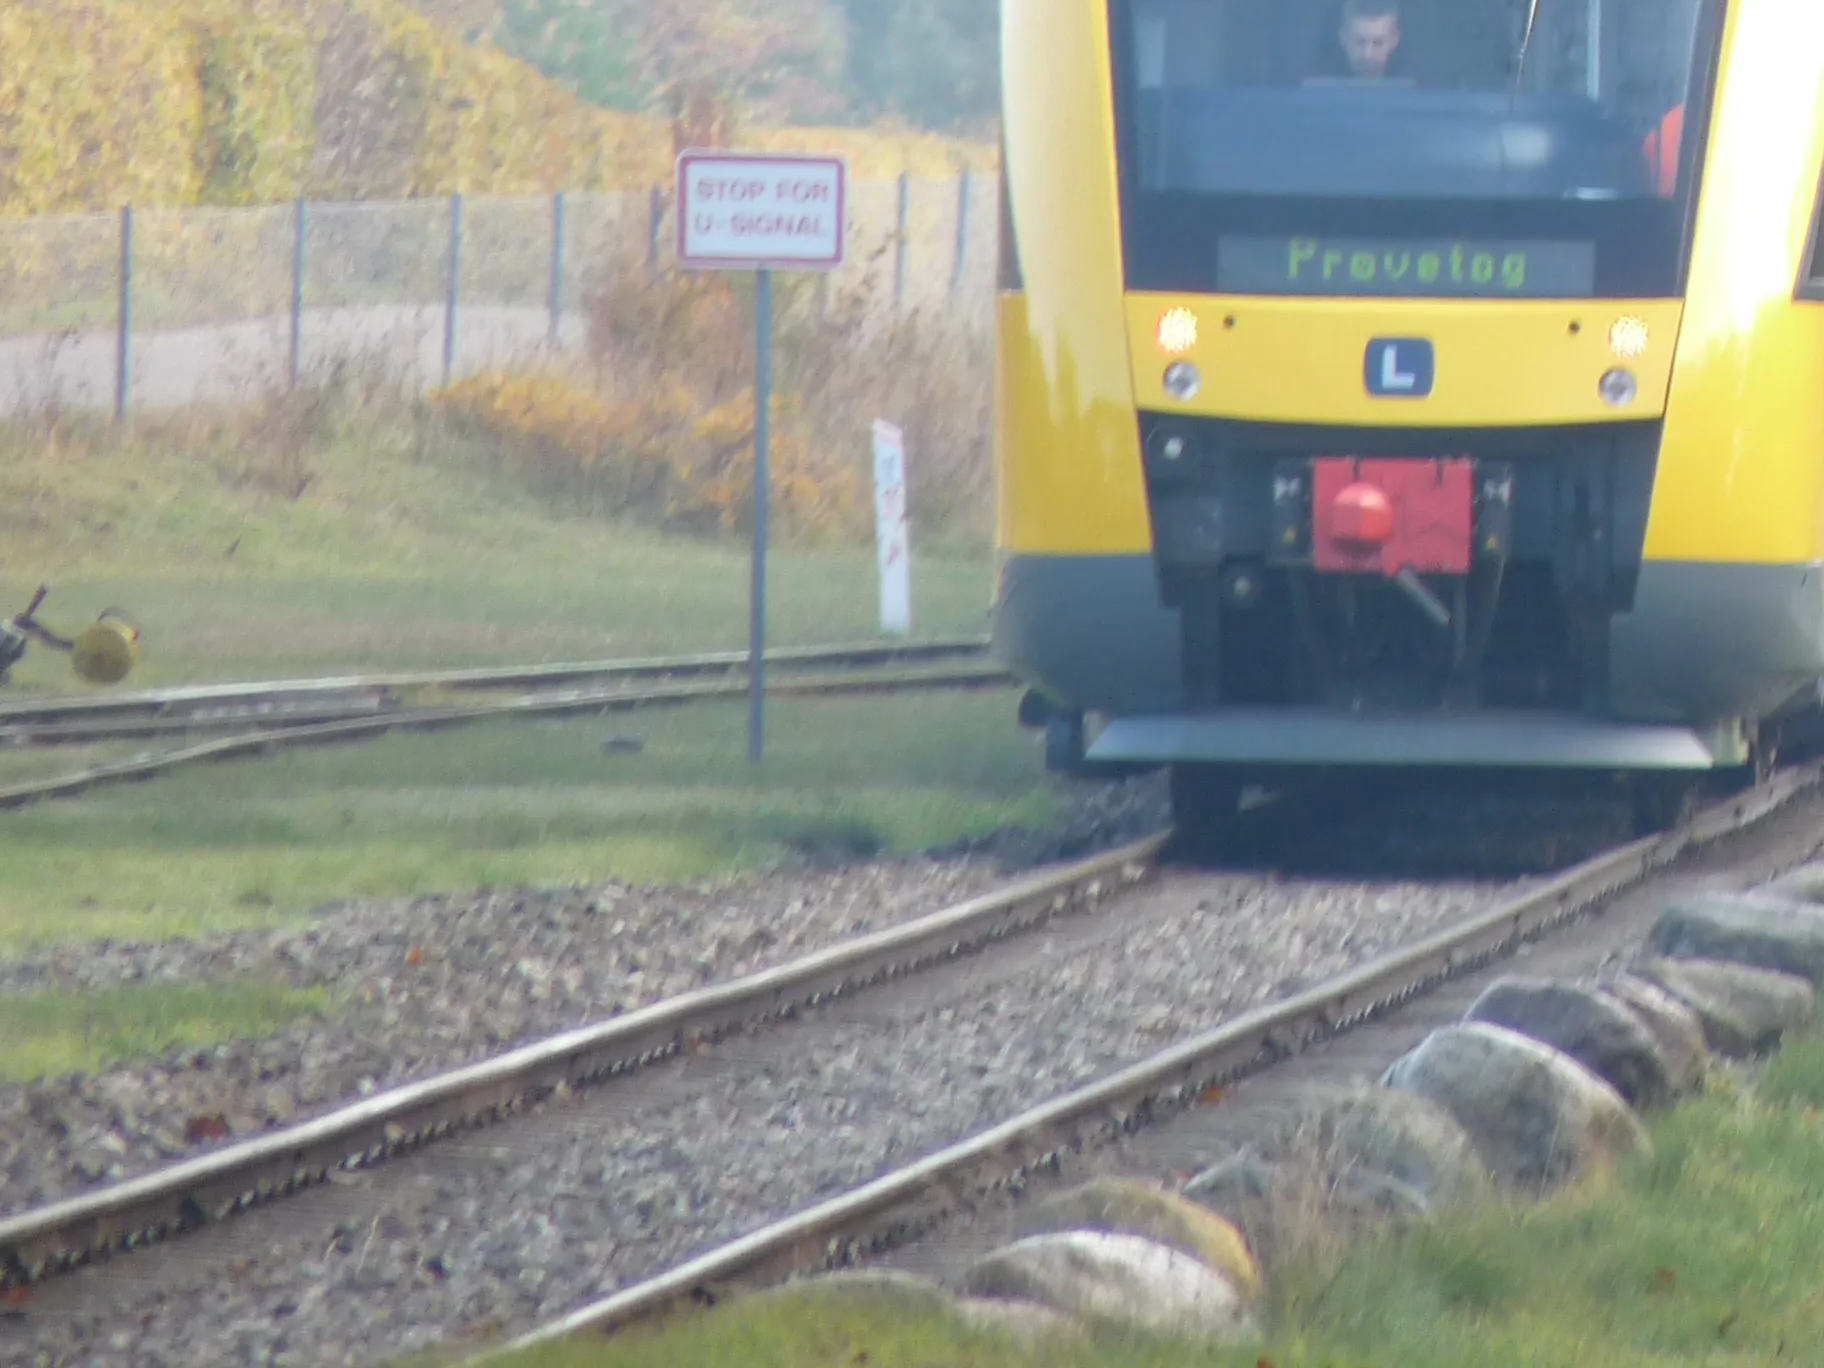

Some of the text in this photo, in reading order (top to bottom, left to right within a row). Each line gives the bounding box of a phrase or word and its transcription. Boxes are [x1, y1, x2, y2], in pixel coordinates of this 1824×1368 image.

[696, 178, 830, 204] STOP FOR
[1381, 344, 1417, 391] L
